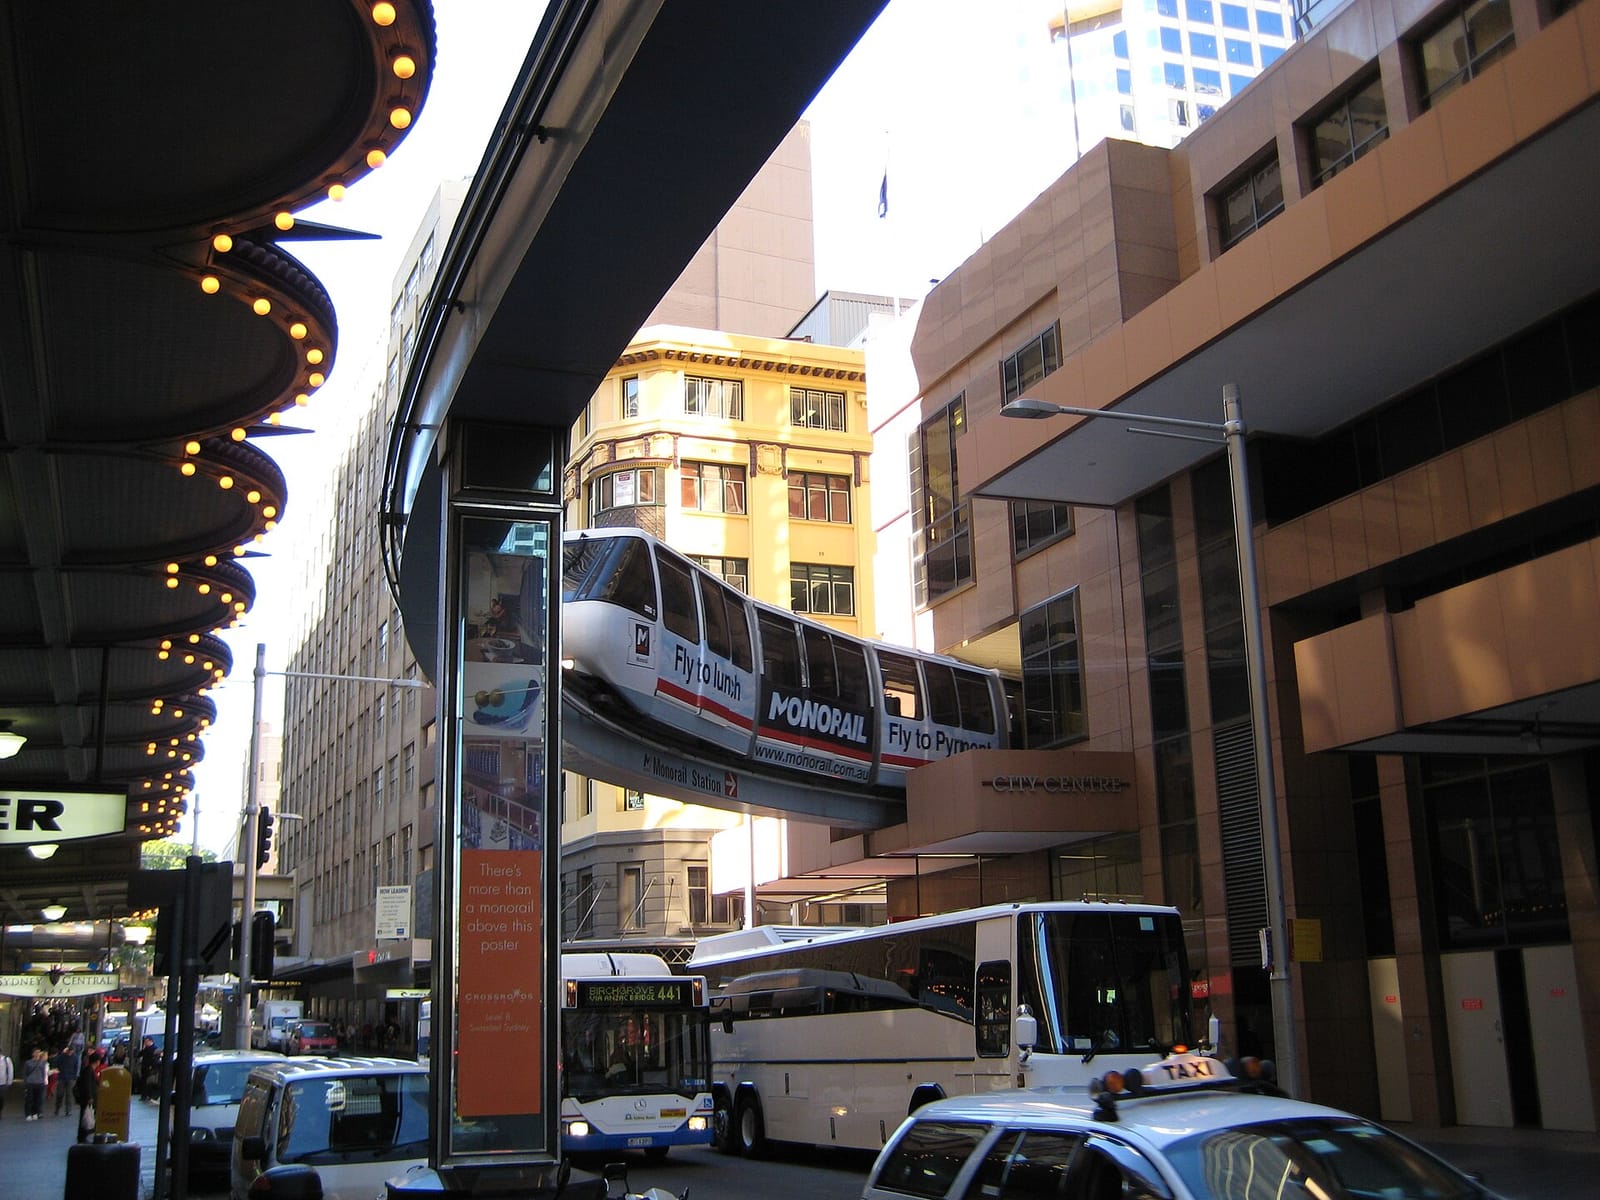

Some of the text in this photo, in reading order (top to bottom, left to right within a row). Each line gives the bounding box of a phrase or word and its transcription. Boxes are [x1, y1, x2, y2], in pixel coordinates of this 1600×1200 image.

[674, 643, 694, 685] Fly
[696, 656, 711, 685] to
[768, 691, 868, 744] MONORAIL
[888, 722, 912, 752] Fly
[916, 729, 932, 750] to
[754, 744, 870, 781] www.monorail.com.au
[652, 755, 687, 784] Monorail
[691, 769, 722, 793] Station
[992, 775, 1122, 793] CITY CENTRE
[480, 862, 522, 877] There's
[468, 881, 531, 895] more than
[465, 899, 534, 913] a monorail
[467, 917, 533, 932] above this
[480, 940, 519, 954] poster
[62, 975, 114, 986] CENTRAL
[589, 985, 681, 1001] BIRCHGROVE 441
[1161, 1060, 1216, 1081] TAXI
